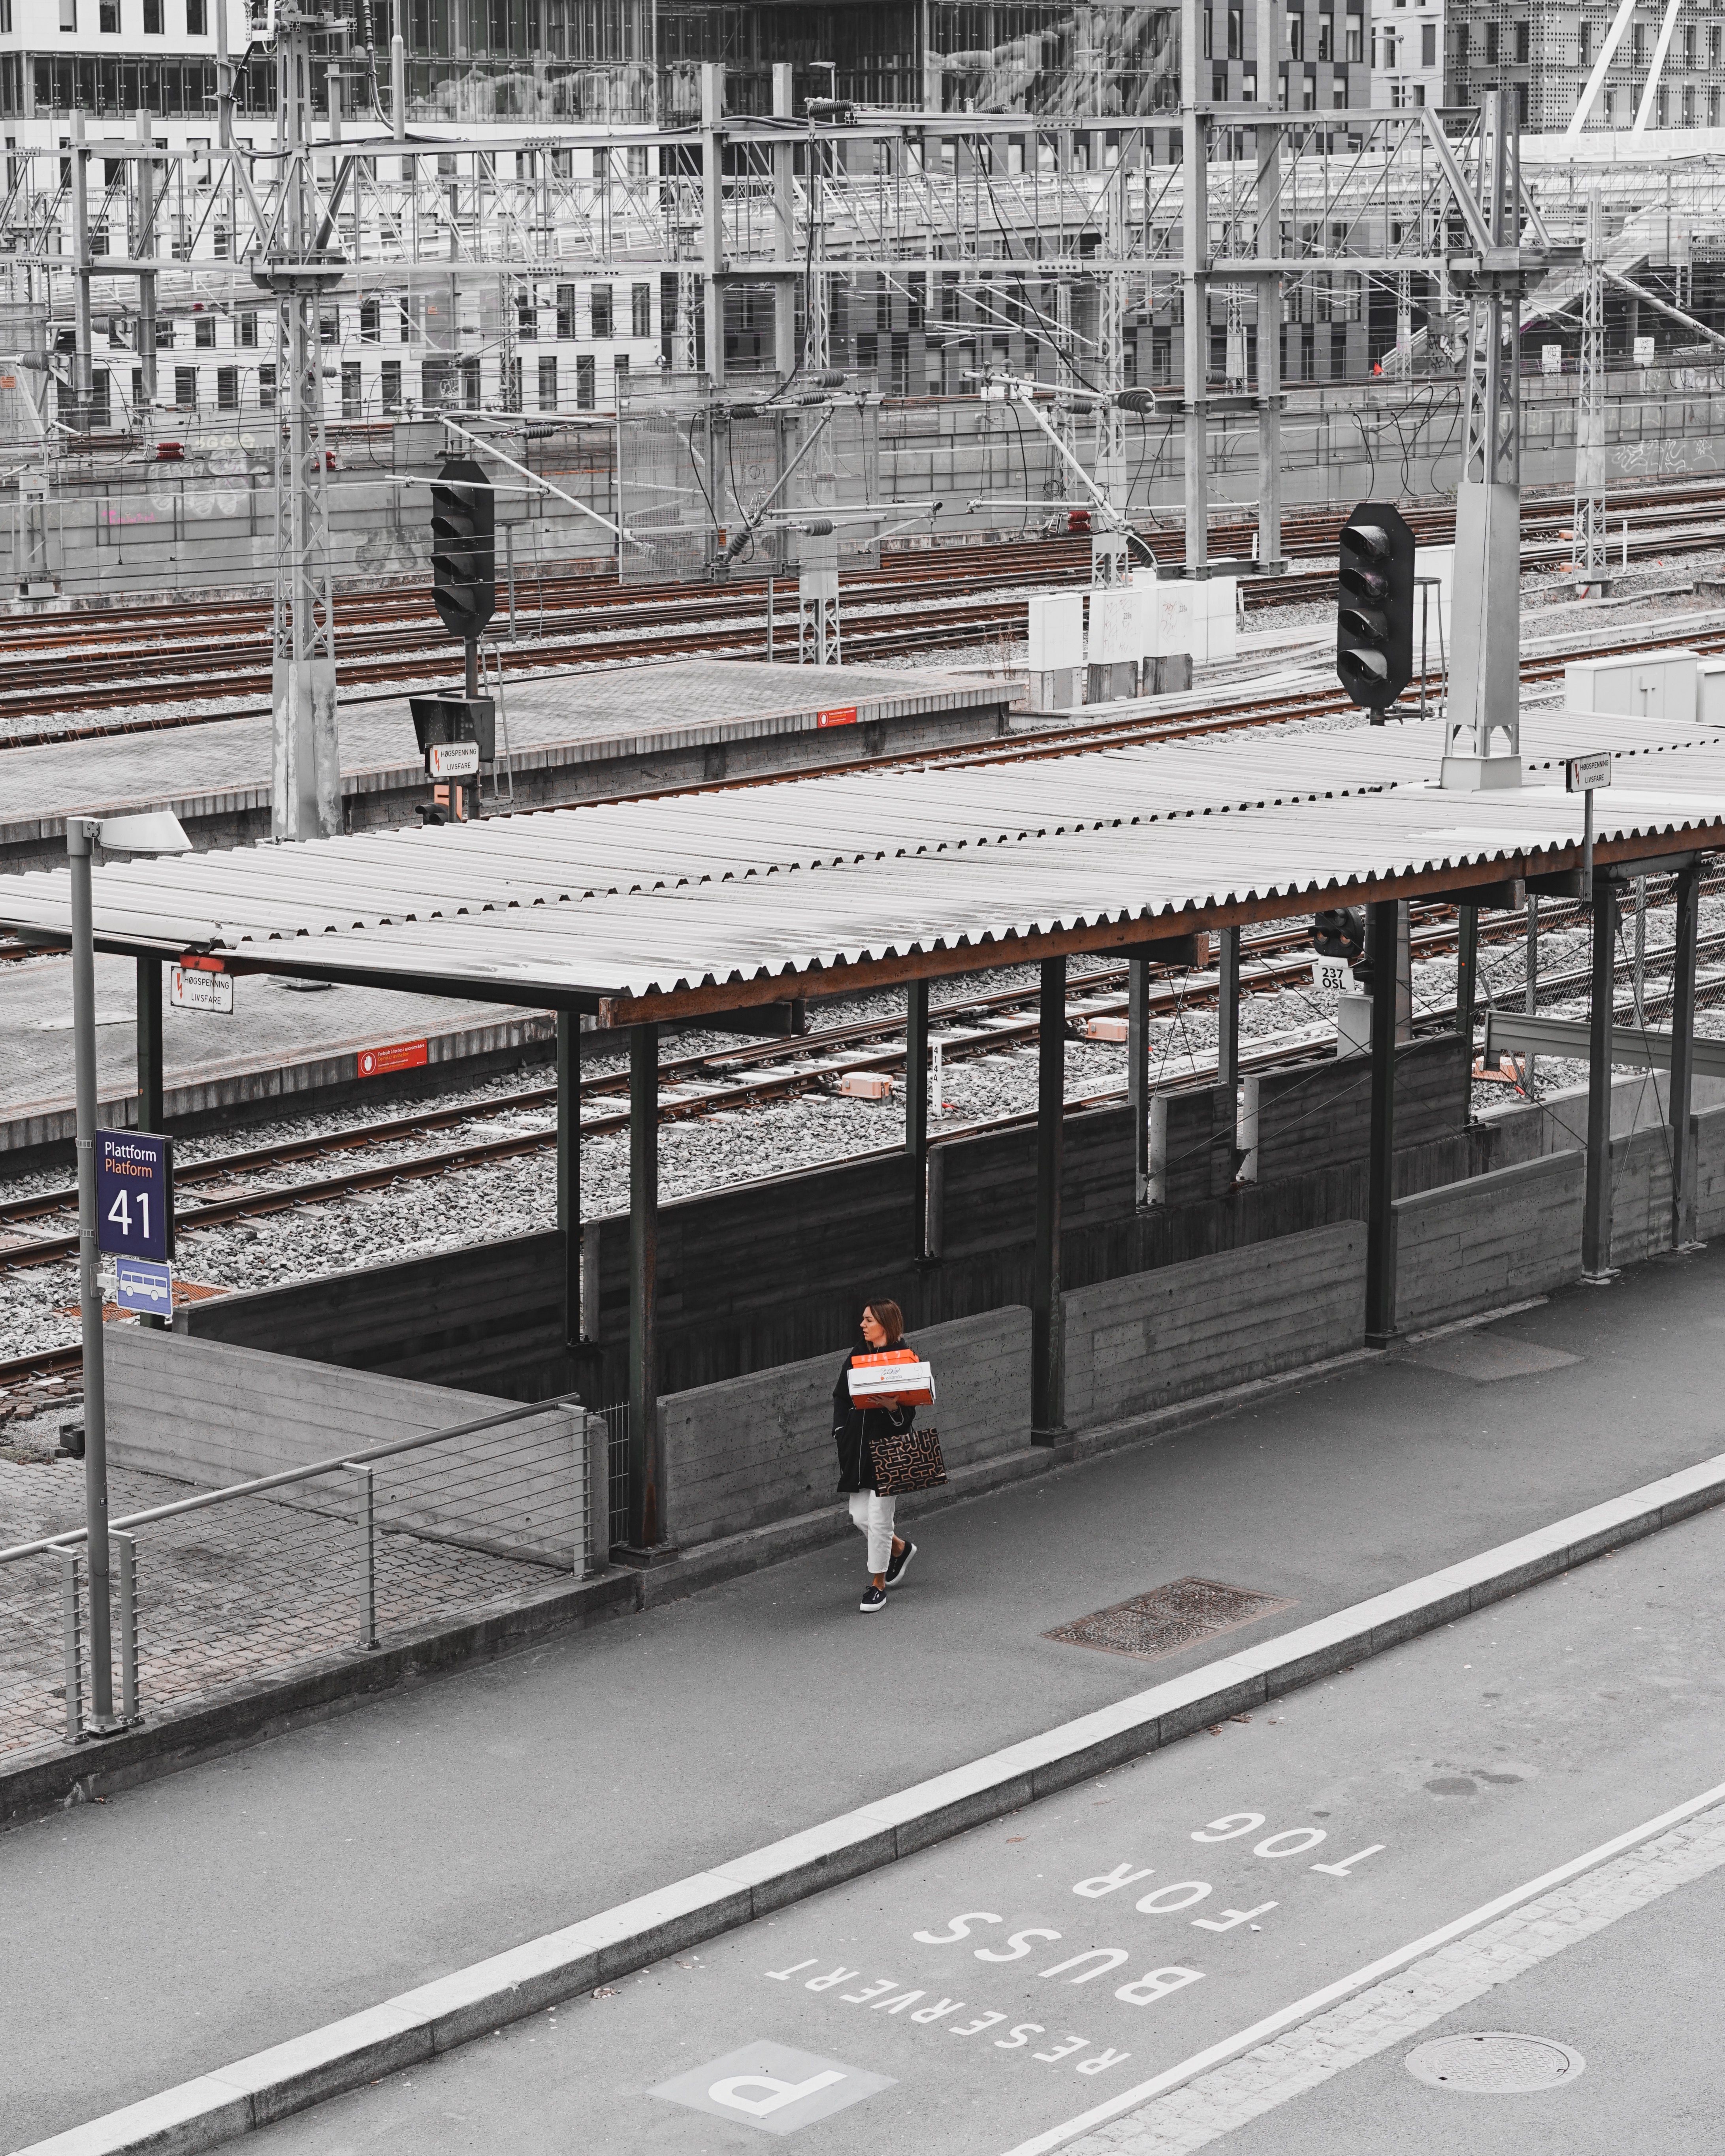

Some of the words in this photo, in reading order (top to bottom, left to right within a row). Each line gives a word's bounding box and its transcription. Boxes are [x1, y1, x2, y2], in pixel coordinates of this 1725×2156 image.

[441, 748, 476, 757] HØGSPENNING
[447, 762, 471, 770] LIVSFARE
[1580, 760, 1609, 771] HØGSPENNING
[1585, 774, 1604, 784] LIVSFARE
[1322, 967, 1343, 978] 237
[184, 976, 229, 989] HØGSPENNING
[1322, 978, 1346, 990] OSL
[191, 993, 222, 1005] LIVSFARE
[105, 1141, 156, 1162] Plattform
[105, 1158, 153, 1178] Platform
[108, 1189, 150, 1238] 41
[1190, 1812, 1386, 1877] TOG
[1072, 1863, 1279, 1932] FOR
[912, 1912, 1206, 2006] BUSS
[764, 1958, 1132, 2075] RESERVERT
[707, 2069, 848, 2118] P
